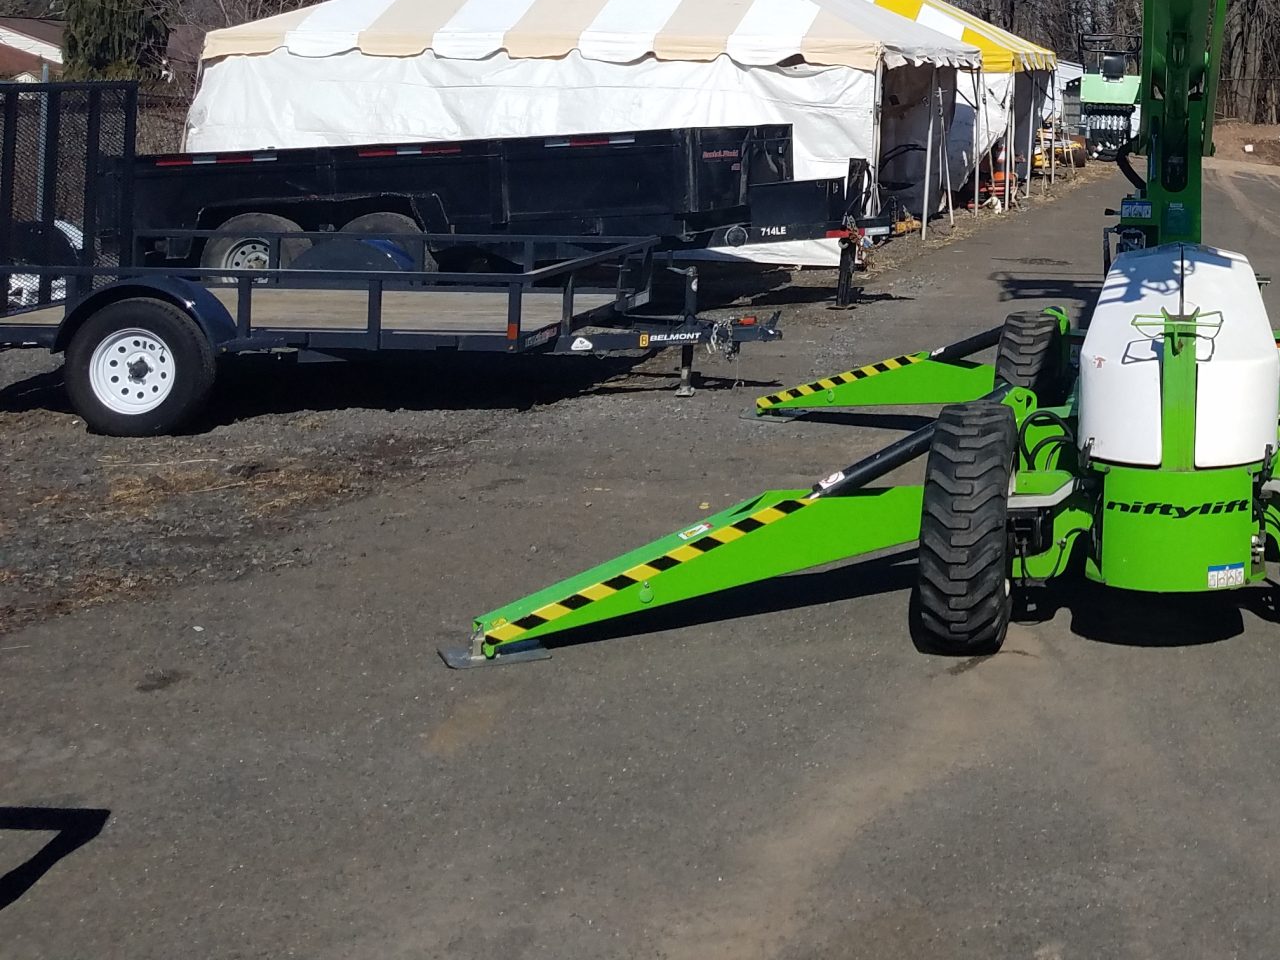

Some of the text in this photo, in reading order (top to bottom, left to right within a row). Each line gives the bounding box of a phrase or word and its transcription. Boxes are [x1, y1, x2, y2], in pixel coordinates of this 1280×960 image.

[760, 226, 787, 236] 714LE
[650, 332, 702, 341] BELMONT
[1106, 499, 1249, 518] niftylift
